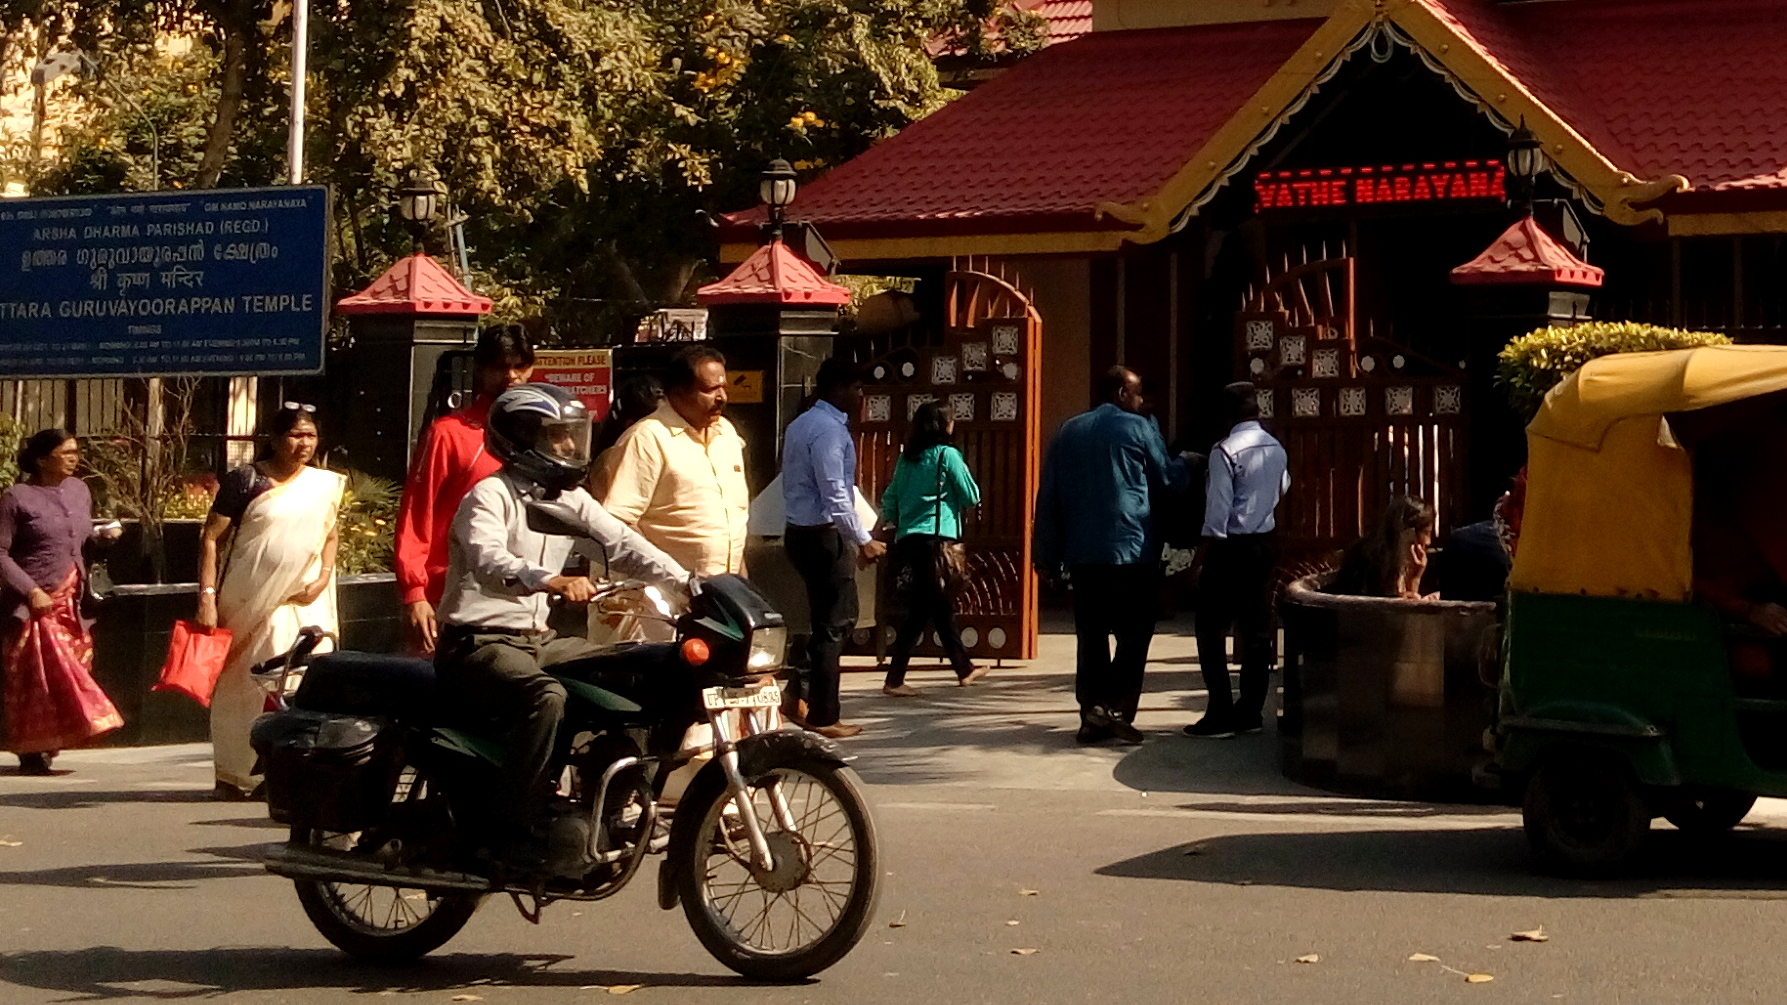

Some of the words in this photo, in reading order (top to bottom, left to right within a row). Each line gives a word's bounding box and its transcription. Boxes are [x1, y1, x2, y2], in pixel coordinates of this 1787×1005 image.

[33, 226, 77, 241] ARSHA
[84, 224, 140, 240] DHARMA
[147, 221, 214, 237] PARISHAD
[59, 297, 235, 318] GURUVAYOORAPPAN
[241, 293, 313, 313] TEMPLE
[578, 355, 607, 365] PLEASE
